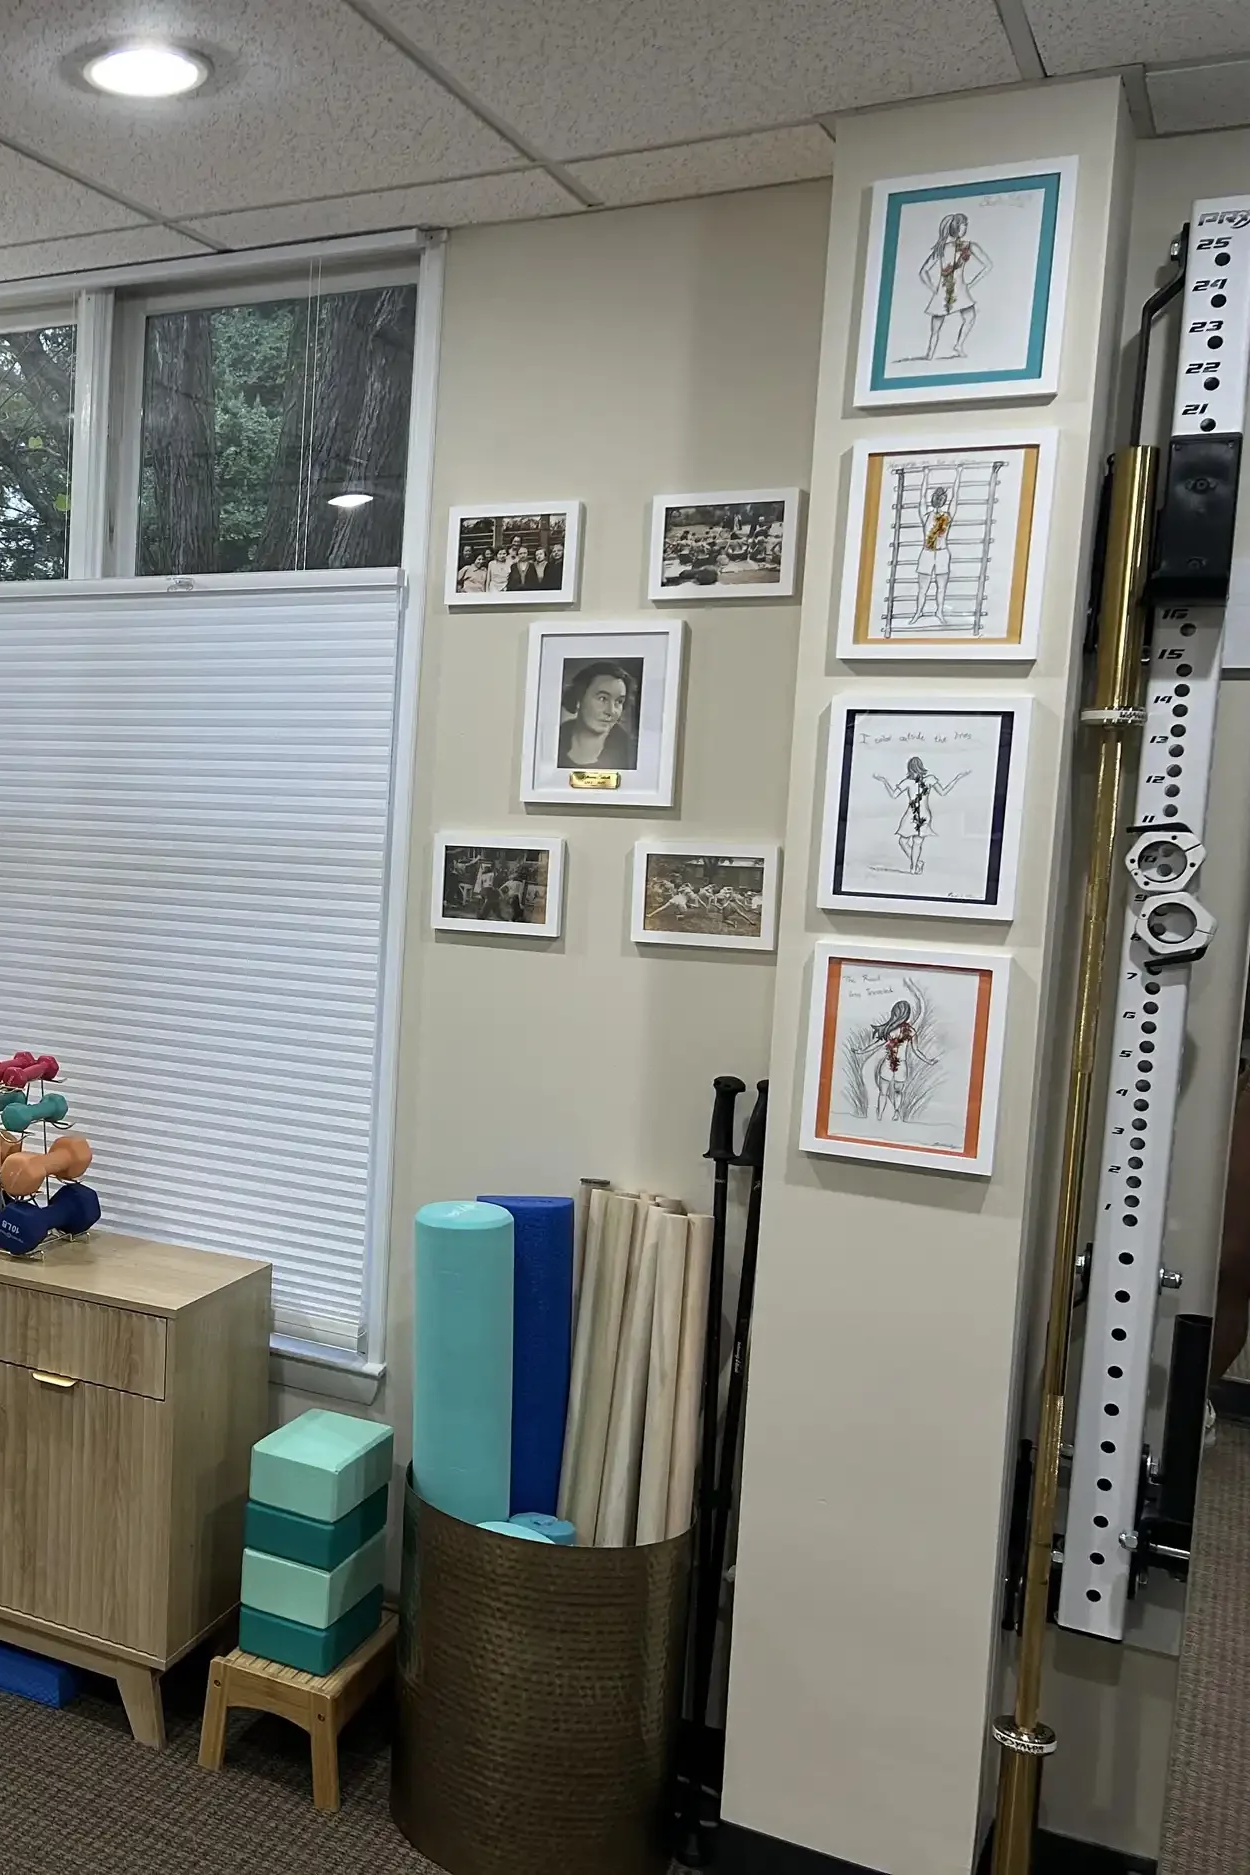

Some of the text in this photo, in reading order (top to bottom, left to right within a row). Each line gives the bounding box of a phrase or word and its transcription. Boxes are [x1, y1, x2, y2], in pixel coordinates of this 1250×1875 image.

[1196, 236, 1233, 250] 25
[1192, 278, 1228, 292] 24
[1188, 320, 1224, 334] 23
[1185, 362, 1221, 375] 22
[1181, 403, 1209, 416] 21
[1162, 608, 1188, 620] 16
[1158, 649, 1185, 660] 15
[1153, 695, 1172, 704] 14
[859, 733, 870, 744] I
[934, 735, 948, 743] the
[1150, 736, 1169, 744] 13
[1145, 775, 1165, 784] 12
[1141, 815, 1155, 823] 11
[1126, 972, 1138, 980] 7
[1122, 1011, 1136, 1019] 6
[1119, 1050, 1132, 1058] 5
[1115, 1088, 1128, 1097] 4
[1112, 1127, 1125, 1135] 3
[1108, 1165, 1121, 1173] 2
[2, 1220, 20, 1234] 10LB
